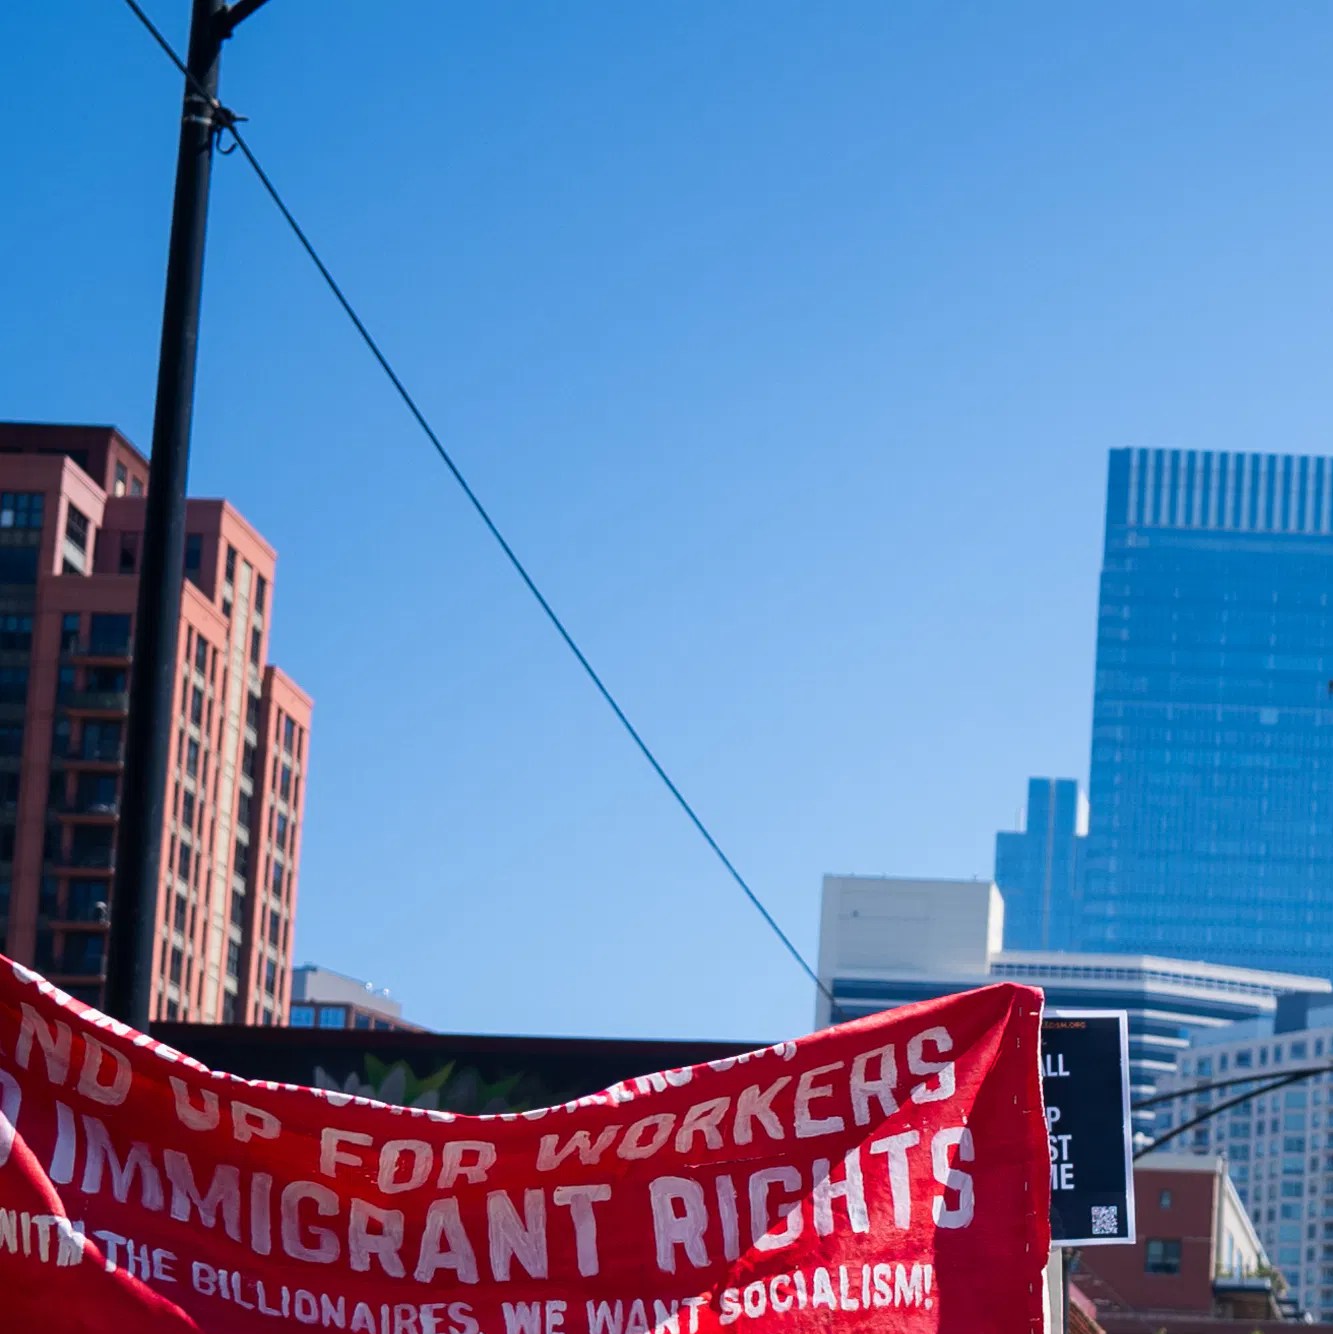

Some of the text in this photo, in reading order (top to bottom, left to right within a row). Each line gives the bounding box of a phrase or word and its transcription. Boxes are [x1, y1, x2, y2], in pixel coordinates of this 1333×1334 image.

[50, 1100, 611, 1284] IMMIGRANT
[649, 1126, 976, 1275] RIGHTS
[168, 1075, 282, 1143] UP
[320, 1127, 497, 1195] FOR
[535, 1025, 957, 1171] WORKERS
[92, 1229, 178, 1283] THE
[718, 1262, 934, 1327] SOCIALISM!
